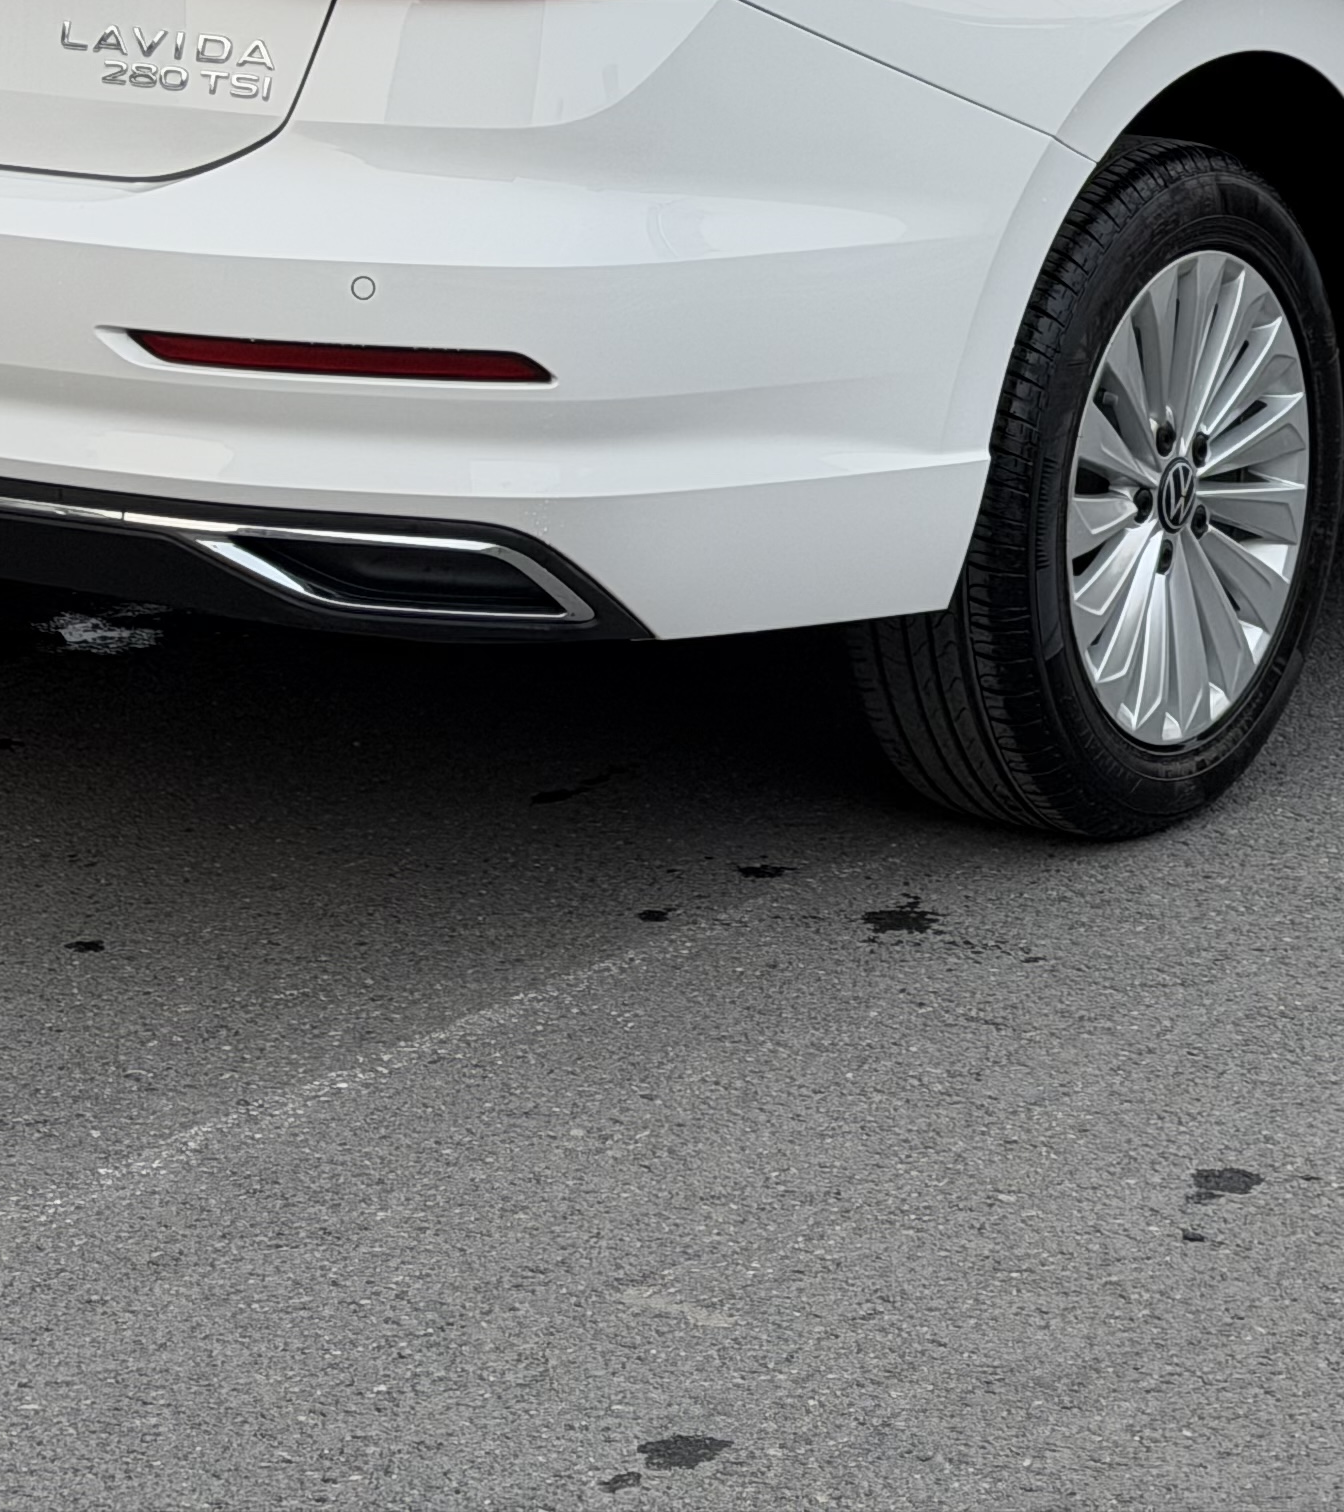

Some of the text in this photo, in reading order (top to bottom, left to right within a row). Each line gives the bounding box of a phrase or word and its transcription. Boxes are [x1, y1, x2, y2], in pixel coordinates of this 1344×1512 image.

[60, 20, 276, 71] LAVIDA
[101, 60, 273, 101] 280 TSI
